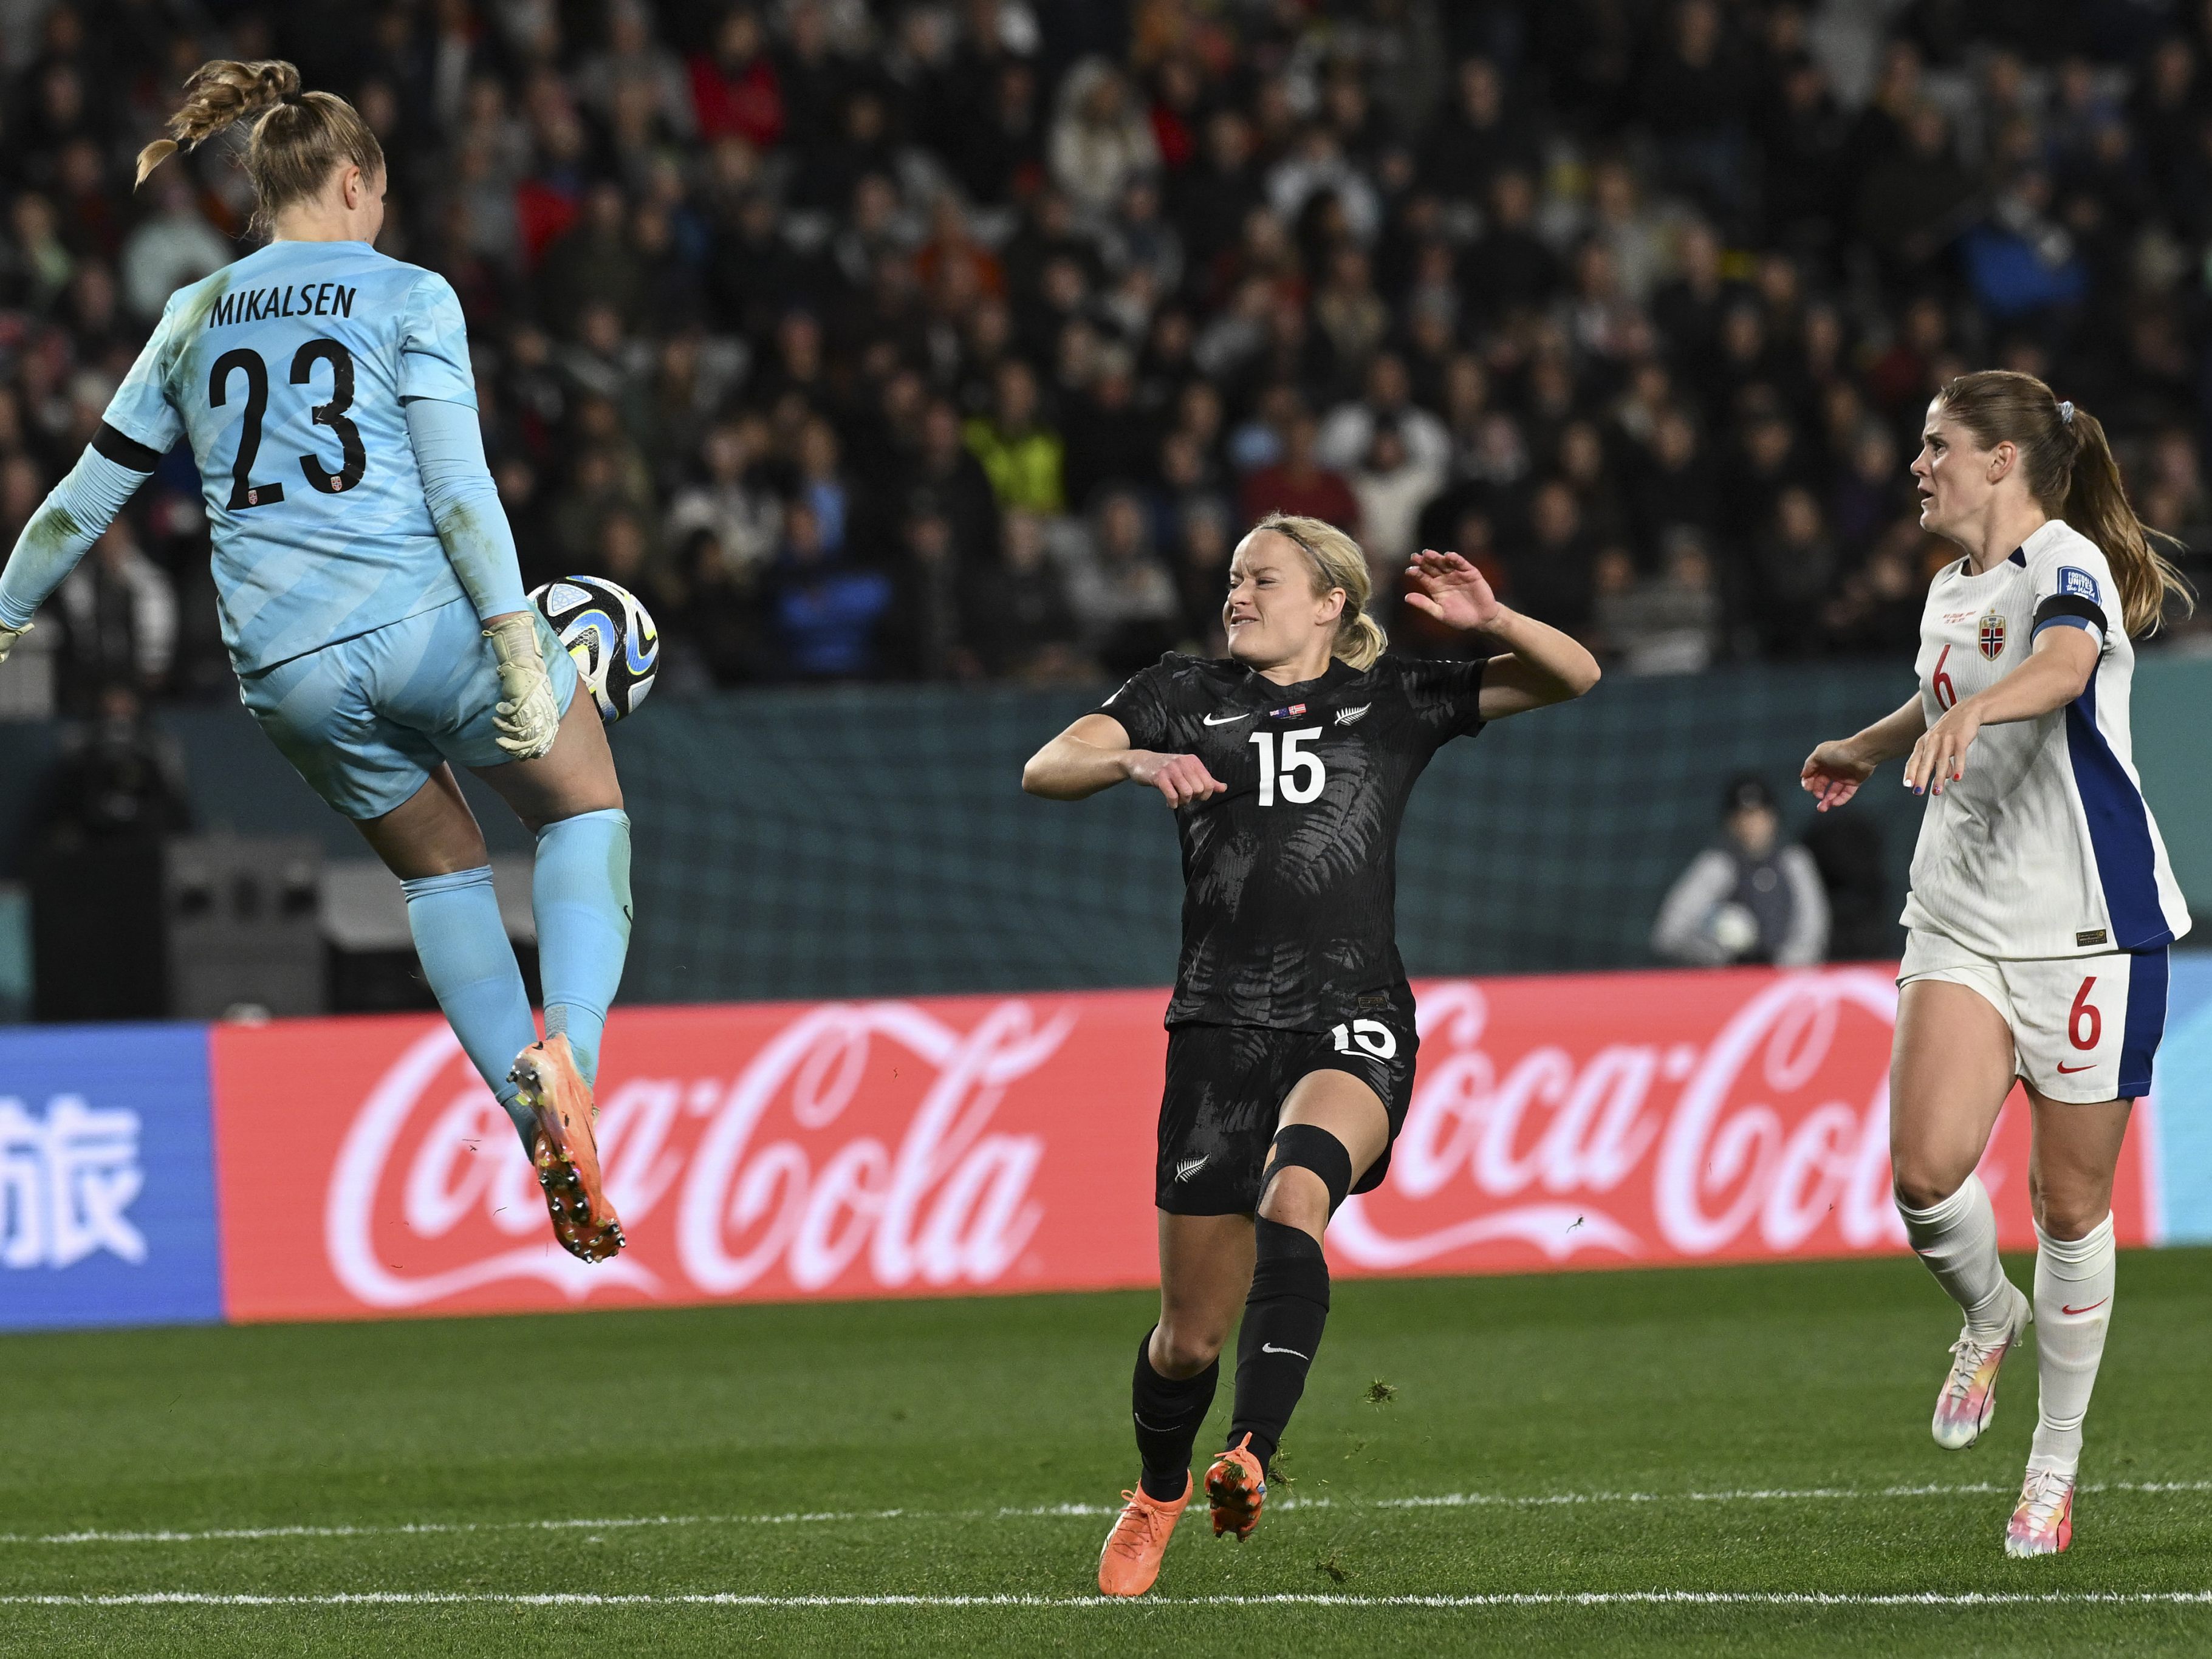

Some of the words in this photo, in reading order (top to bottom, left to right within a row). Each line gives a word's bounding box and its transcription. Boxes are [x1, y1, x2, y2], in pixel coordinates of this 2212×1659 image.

[209, 283, 357, 328] MIKALSEN
[208, 338, 367, 511] 23
[2068, 572, 2092, 584] FOOTBALL
[2068, 577, 2094, 591] UNITES
[2078, 584, 2095, 598] World
[1933, 643, 1957, 711] 6
[1248, 727, 1326, 807] 15
[2069, 976, 2101, 1050] 6
[1326, 970, 2005, 1268] Coca-Co
